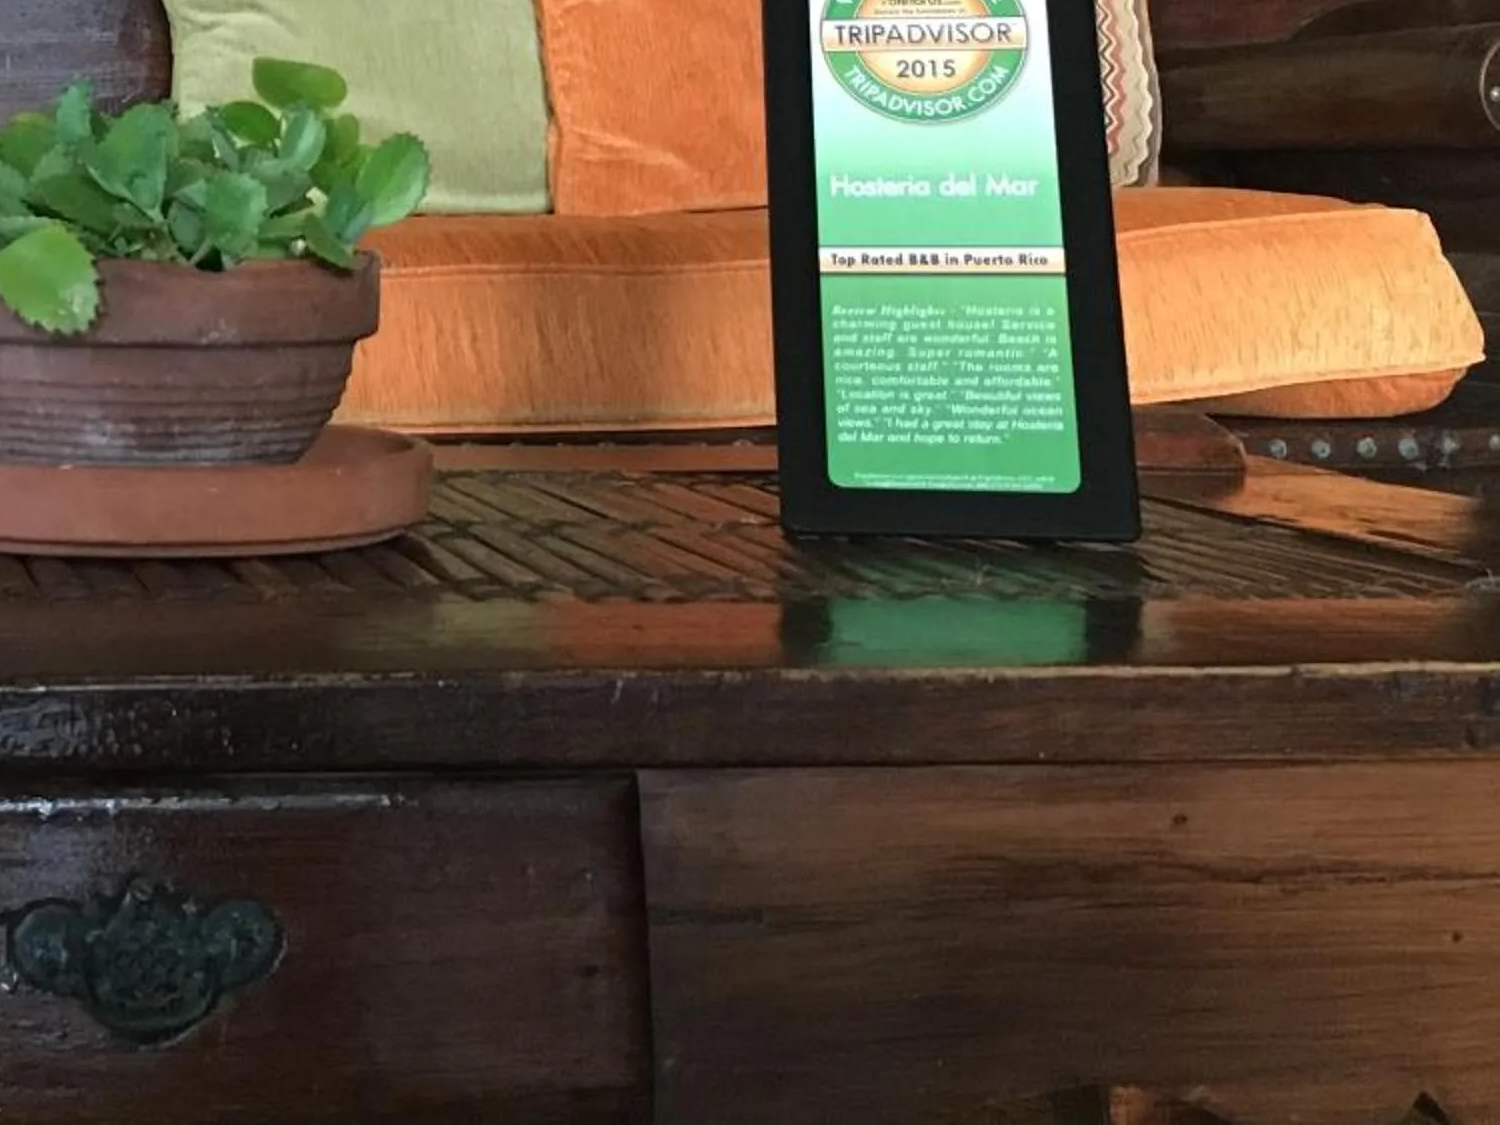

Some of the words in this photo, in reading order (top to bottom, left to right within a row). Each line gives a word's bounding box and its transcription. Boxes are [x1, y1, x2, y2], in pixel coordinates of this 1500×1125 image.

[834, 23, 1012, 45] TRIPADVISOR
[897, 60, 956, 78] 2015
[845, 64, 1009, 116] TRIPADVISOR.COM
[830, 175, 931, 197] Hosteria
[939, 173, 976, 196] del
[986, 176, 1038, 196] Mar
[832, 254, 855, 267] Top
[862, 254, 902, 265] Rated
[909, 255, 939, 265] B&B
[945, 253, 958, 264] in
[965, 254, 1012, 265] Puerto
[1019, 254, 1048, 265] Rico
[904, 320, 941, 331] guest
[833, 334, 857, 343] and
[863, 333, 891, 343] staff
[897, 335, 917, 343] are
[908, 347, 950, 358] Super
[1037, 363, 1059, 373] are
[955, 377, 978, 386] and
[900, 391, 909, 400] is
[836, 404, 849, 414] of
[854, 405, 876, 413] sea
[882, 404, 905, 414] and
[896, 418, 917, 428] had
[922, 420, 929, 428] a
[933, 420, 964, 431] great
[838, 432, 856, 442] del
[861, 432, 883, 442] Mar
[888, 432, 910, 442] and
[914, 432, 944, 444] hope
[948, 433, 959, 443] to
